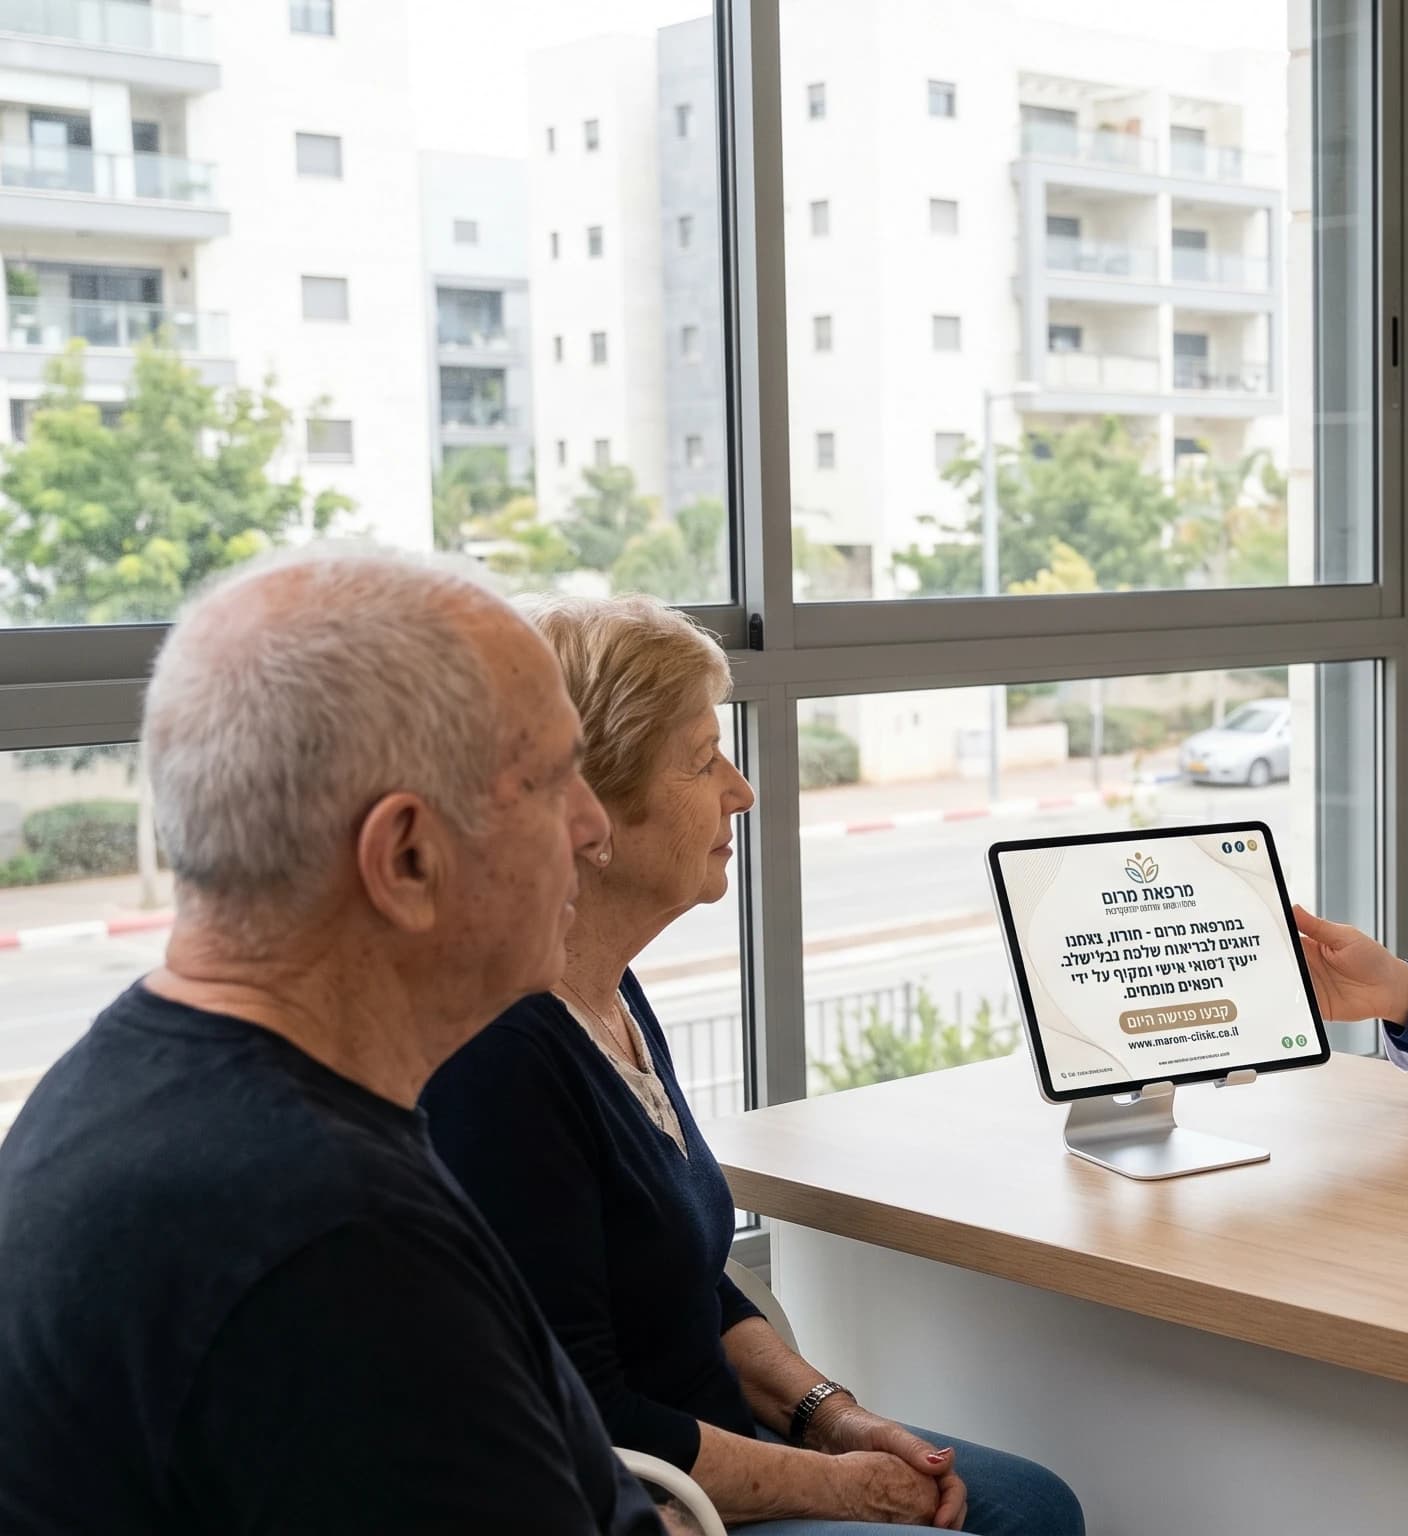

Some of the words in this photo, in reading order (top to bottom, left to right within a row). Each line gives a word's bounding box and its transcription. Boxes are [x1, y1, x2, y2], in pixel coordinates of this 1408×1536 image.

[1101, 889, 1138, 905] מרום
[1141, 884, 1194, 901] מרפאת
[1153, 924, 1187, 938] מרום
[1189, 918, 1245, 935] במרפאת
[1218, 935, 1260, 951] דואגים
[1091, 969, 1110, 983] על
[1155, 962, 1187, 976] אישי
[1070, 972, 1089, 985] ידי
[1177, 976, 1224, 993] רופאים
[1123, 982, 1175, 999] מומחים.
[1199, 1005, 1229, 1021] קבעו
[1126, 1014, 1155, 1029] היום
